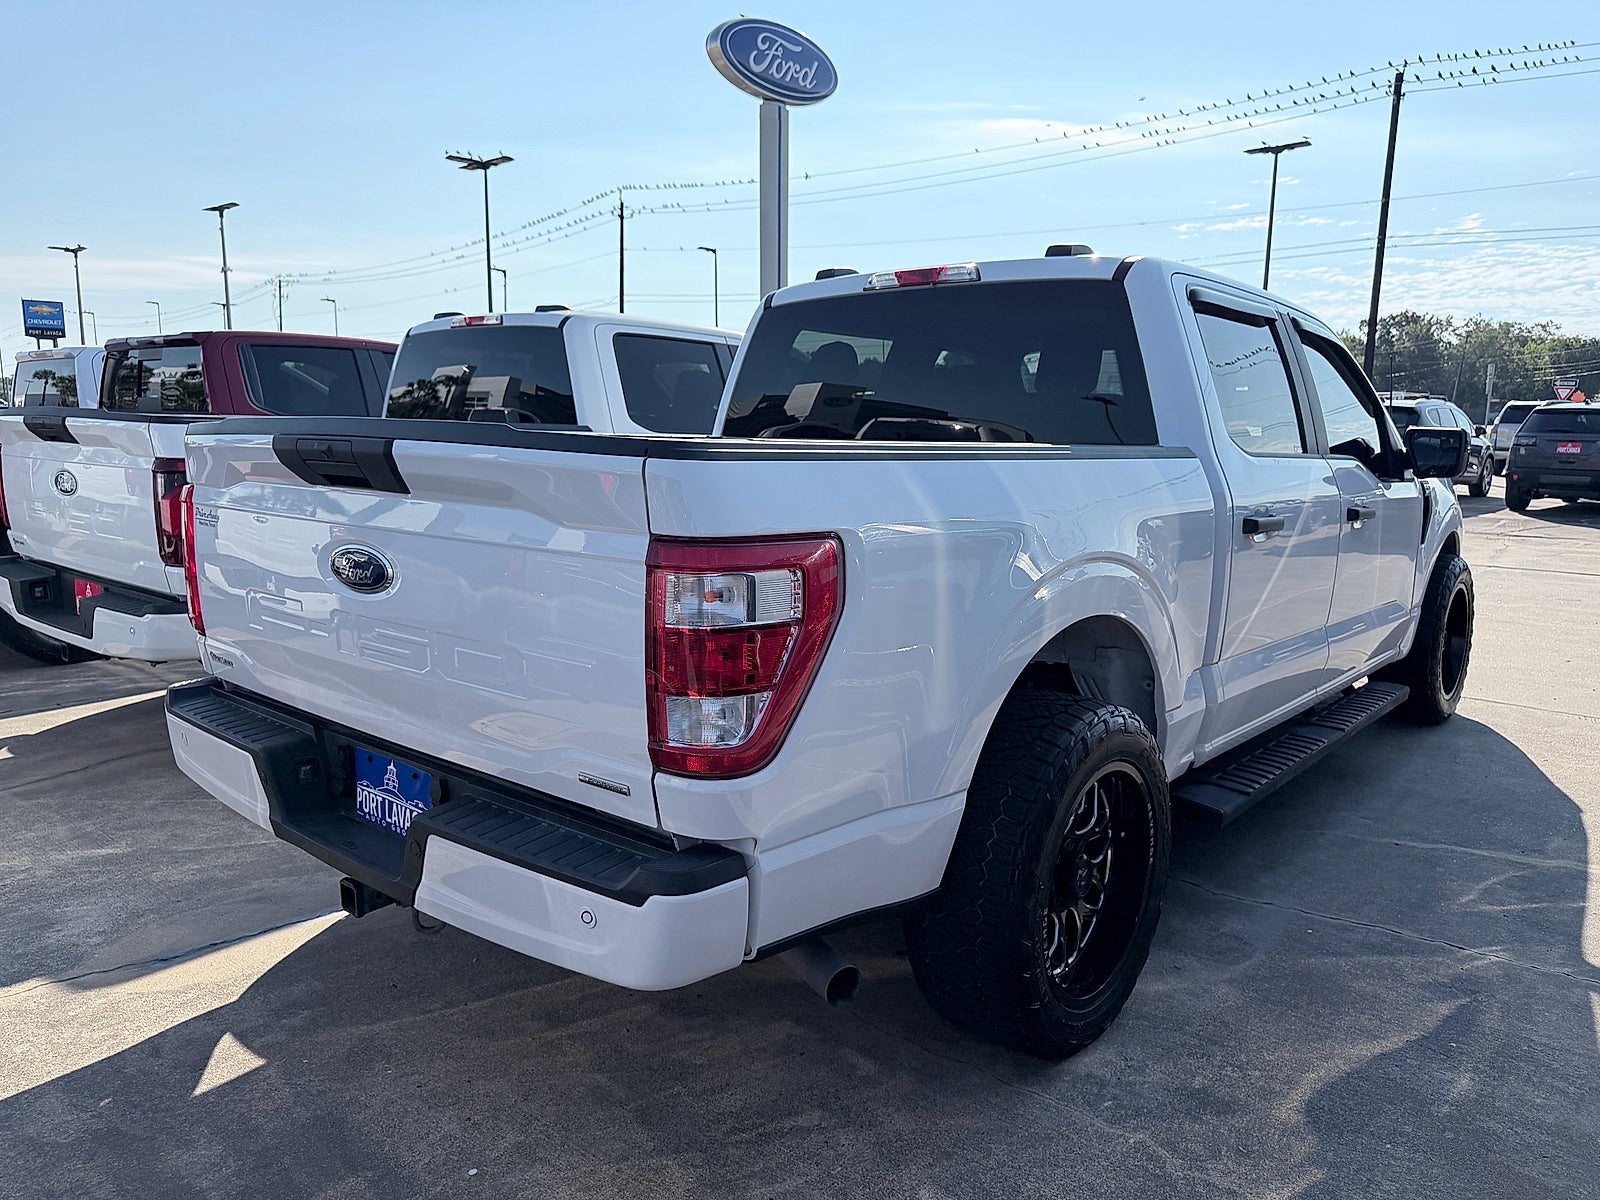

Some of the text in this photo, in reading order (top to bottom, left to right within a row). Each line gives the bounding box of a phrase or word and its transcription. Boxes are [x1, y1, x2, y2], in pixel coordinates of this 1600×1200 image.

[749, 32, 818, 89] Ford
[340, 553, 374, 584] Ford
[356, 786, 383, 819] PORT
[365, 813, 387, 827] AUTO
